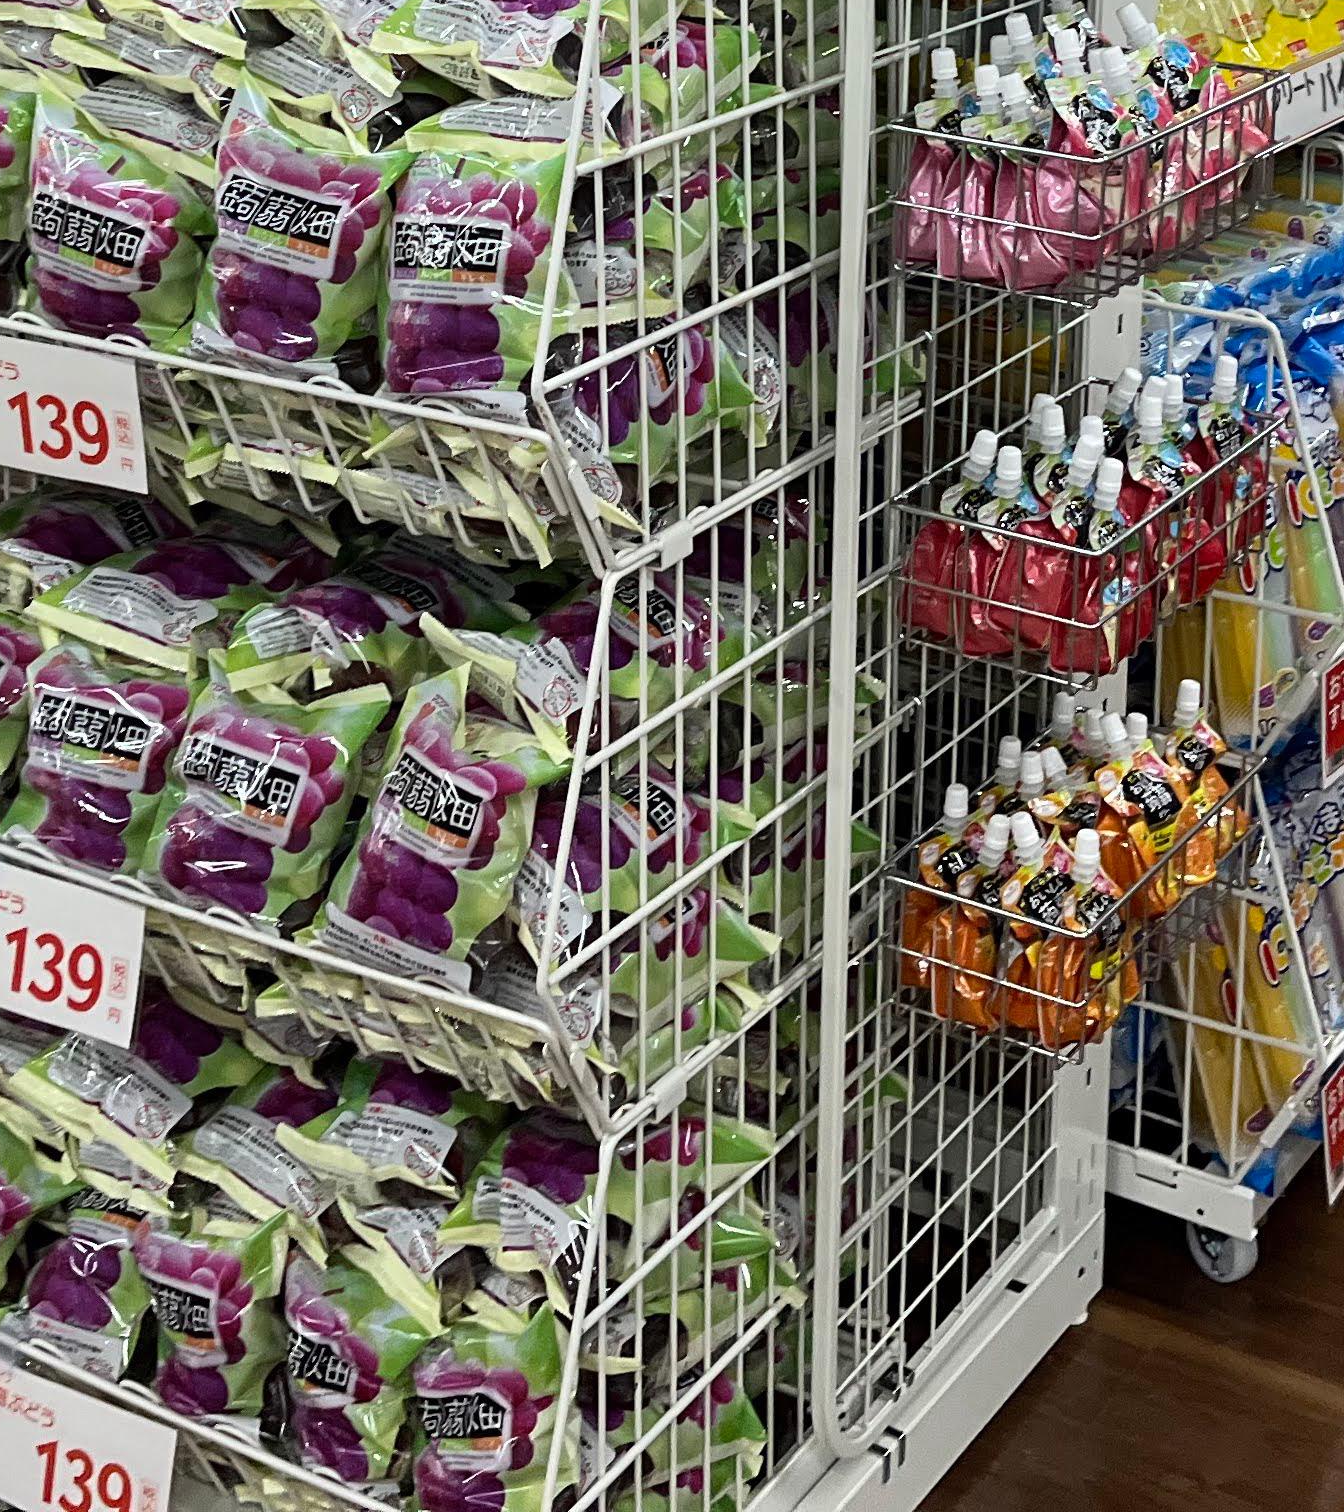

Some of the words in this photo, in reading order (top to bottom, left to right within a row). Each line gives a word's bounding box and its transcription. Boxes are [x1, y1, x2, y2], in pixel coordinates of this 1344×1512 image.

[32, 194, 147, 264] 蒟蒻畑
[217, 175, 341, 241] 蒟蒻畑
[7, 390, 110, 467] 139
[391, 752, 483, 836] 蒟蒻畑
[5, 926, 104, 1013] 139
[35, 1439, 133, 1512] 139
